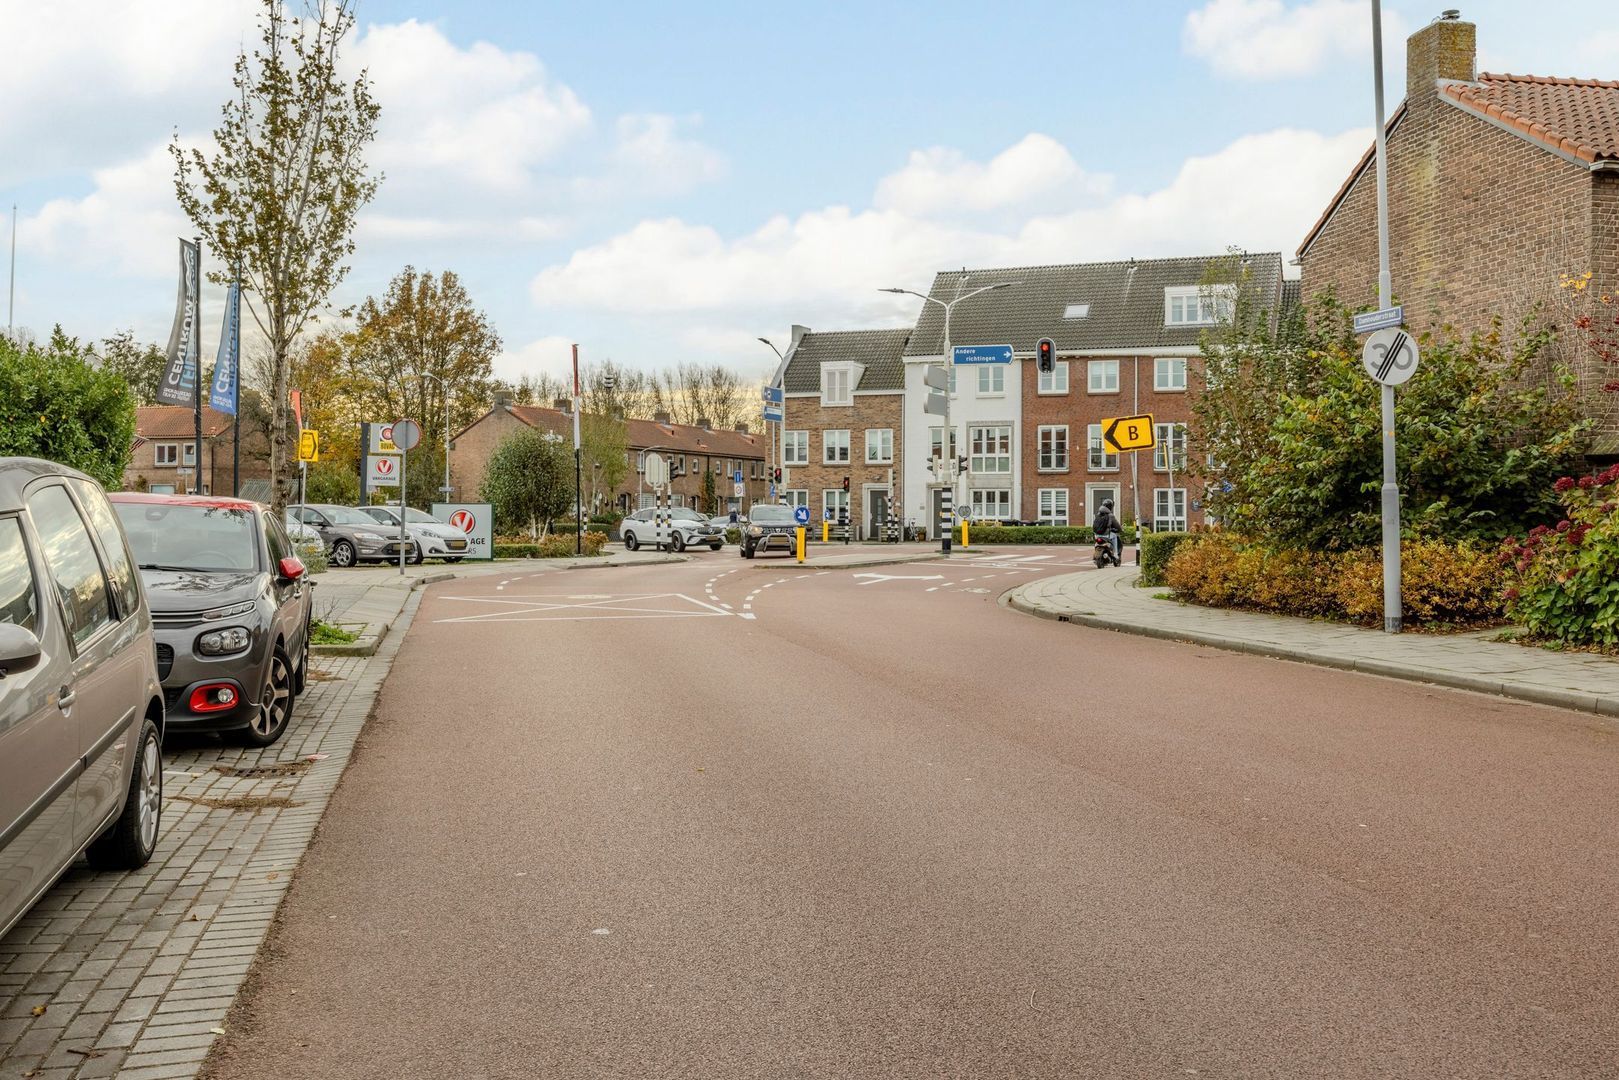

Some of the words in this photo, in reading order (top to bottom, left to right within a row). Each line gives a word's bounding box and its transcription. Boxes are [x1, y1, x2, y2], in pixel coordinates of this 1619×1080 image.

[1370, 343, 1413, 370] 30
[1128, 425, 1139, 441] B
[380, 442, 395, 450] BOVAG
